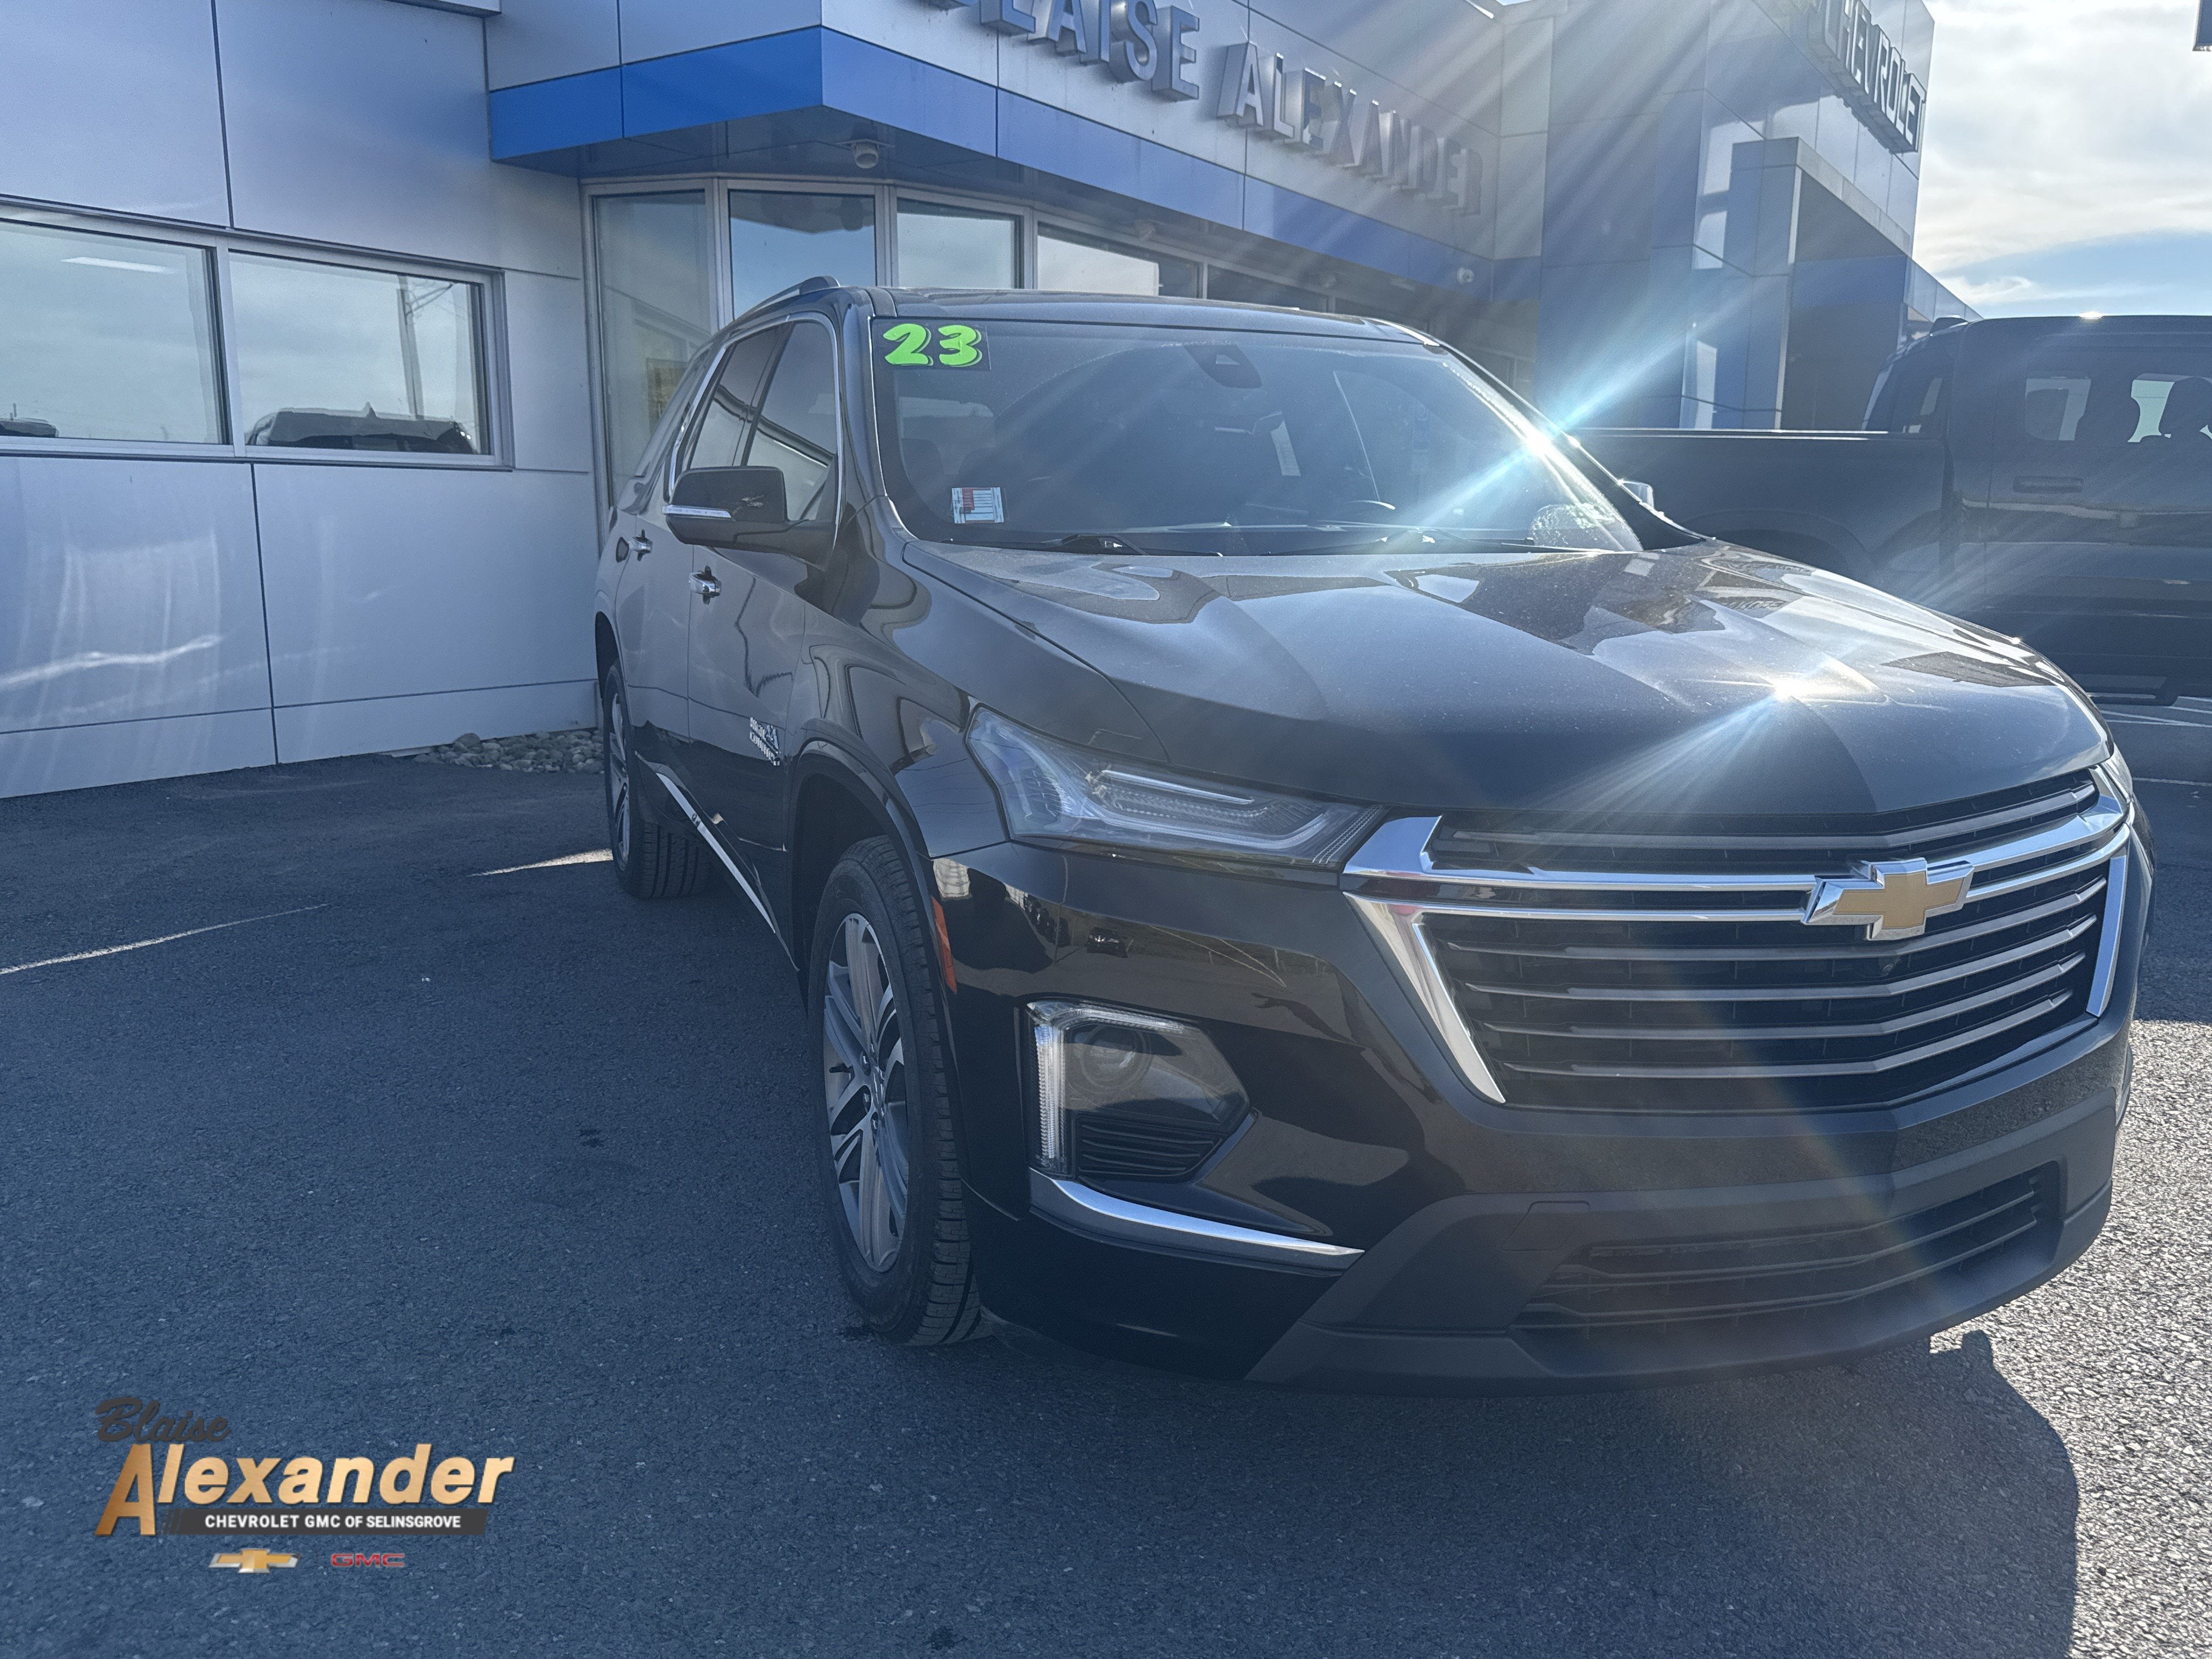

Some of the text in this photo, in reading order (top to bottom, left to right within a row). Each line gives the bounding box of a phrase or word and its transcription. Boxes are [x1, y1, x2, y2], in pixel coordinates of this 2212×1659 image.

[953, 0, 1482, 216] AISE ALEXANDER
[883, 323, 983, 367] 23
